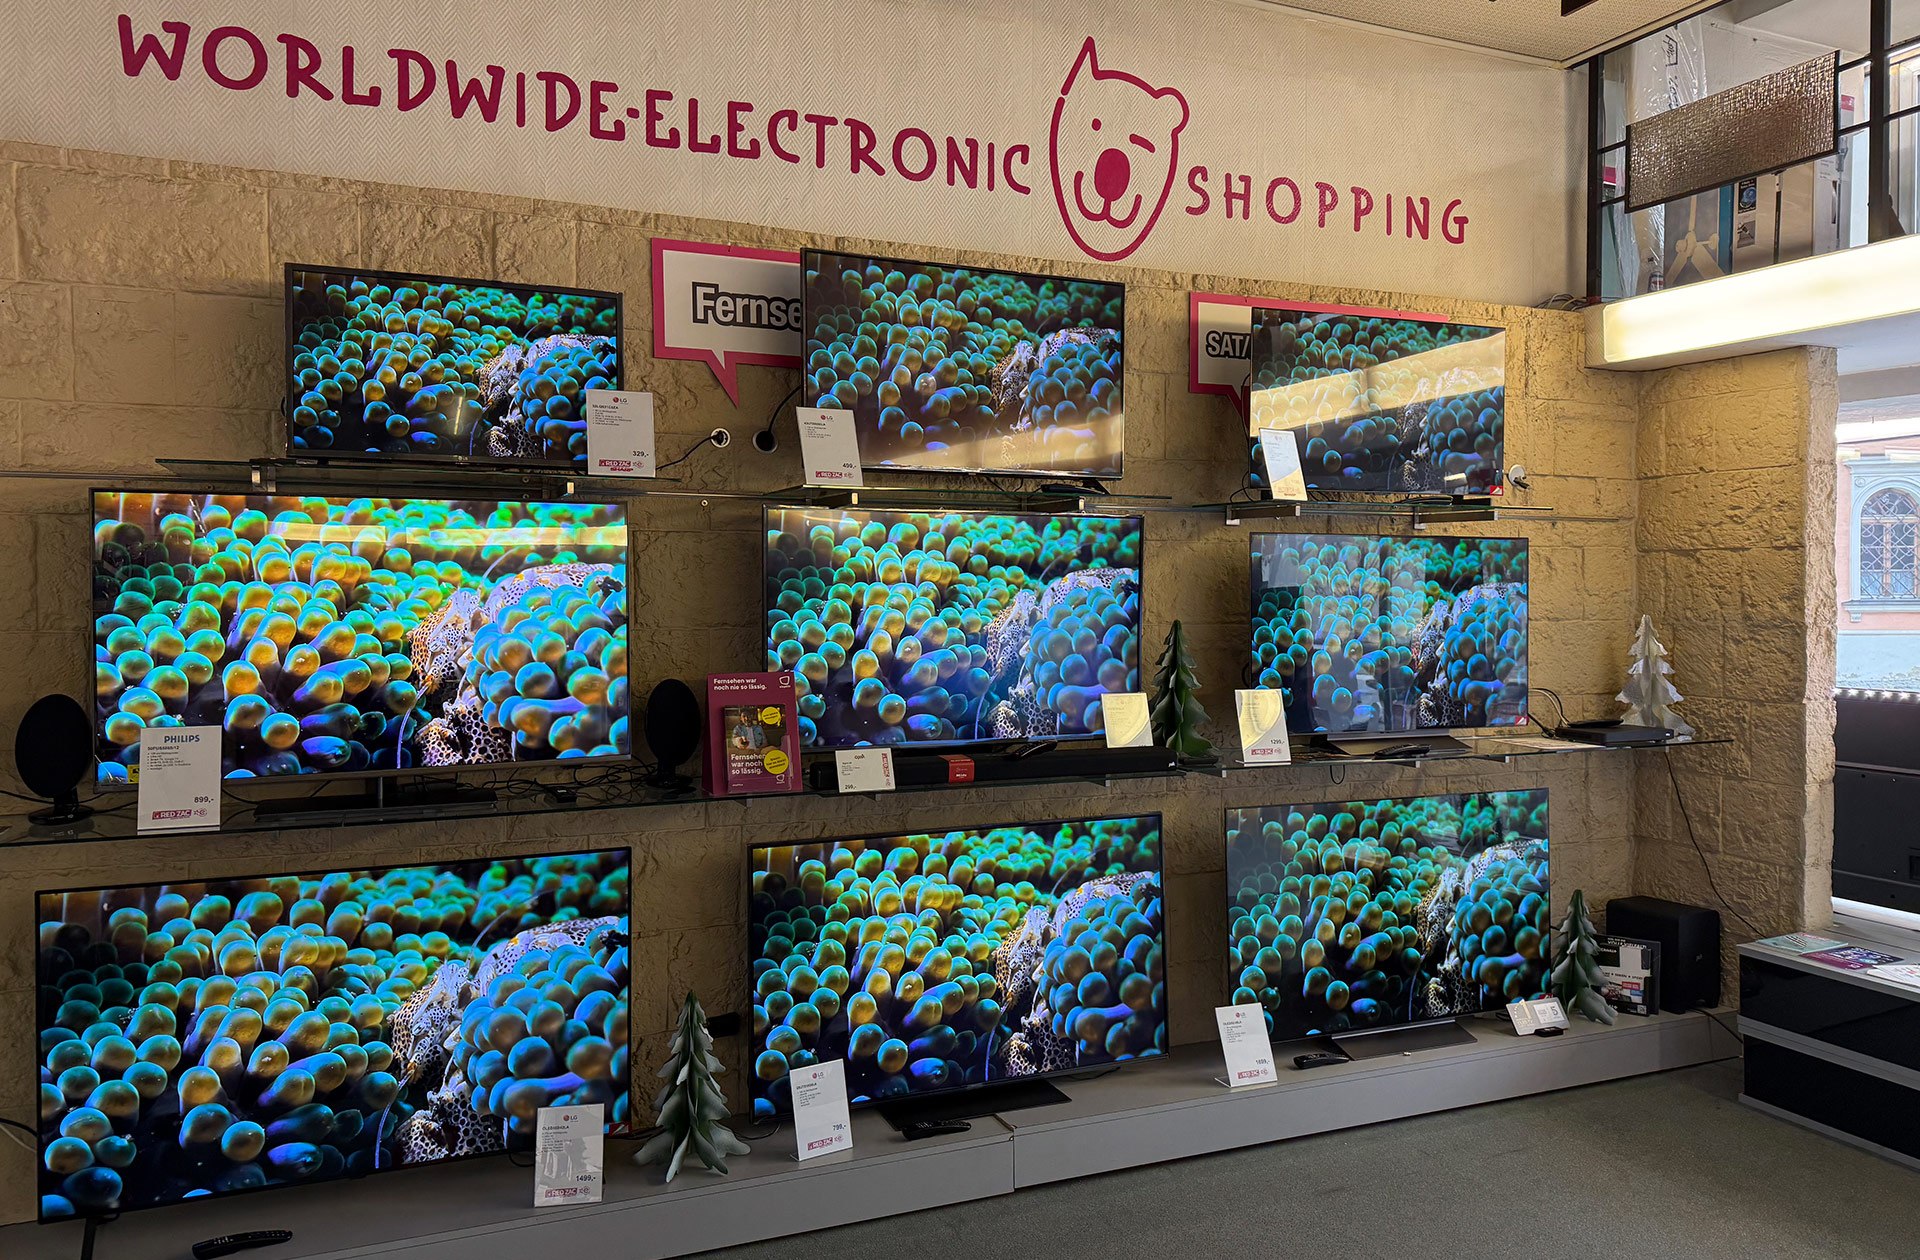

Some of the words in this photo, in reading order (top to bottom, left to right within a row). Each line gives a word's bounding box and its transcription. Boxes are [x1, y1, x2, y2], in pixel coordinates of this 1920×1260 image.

[118, 14, 1031, 195] WORLDWIDE-ELECTRONIC
[1185, 165, 1469, 244] SHOPPING
[632, 450, 649, 458] 329,-
[748, 683, 767, 691] lässig.
[164, 734, 201, 743] PHILIPS
[740, 767, 762, 775] lässig.
[194, 796, 214, 804] 899,-
[160, 810, 176, 819] RED
[176, 809, 191, 818] ZAC
[576, 1174, 596, 1182] 1499,-
